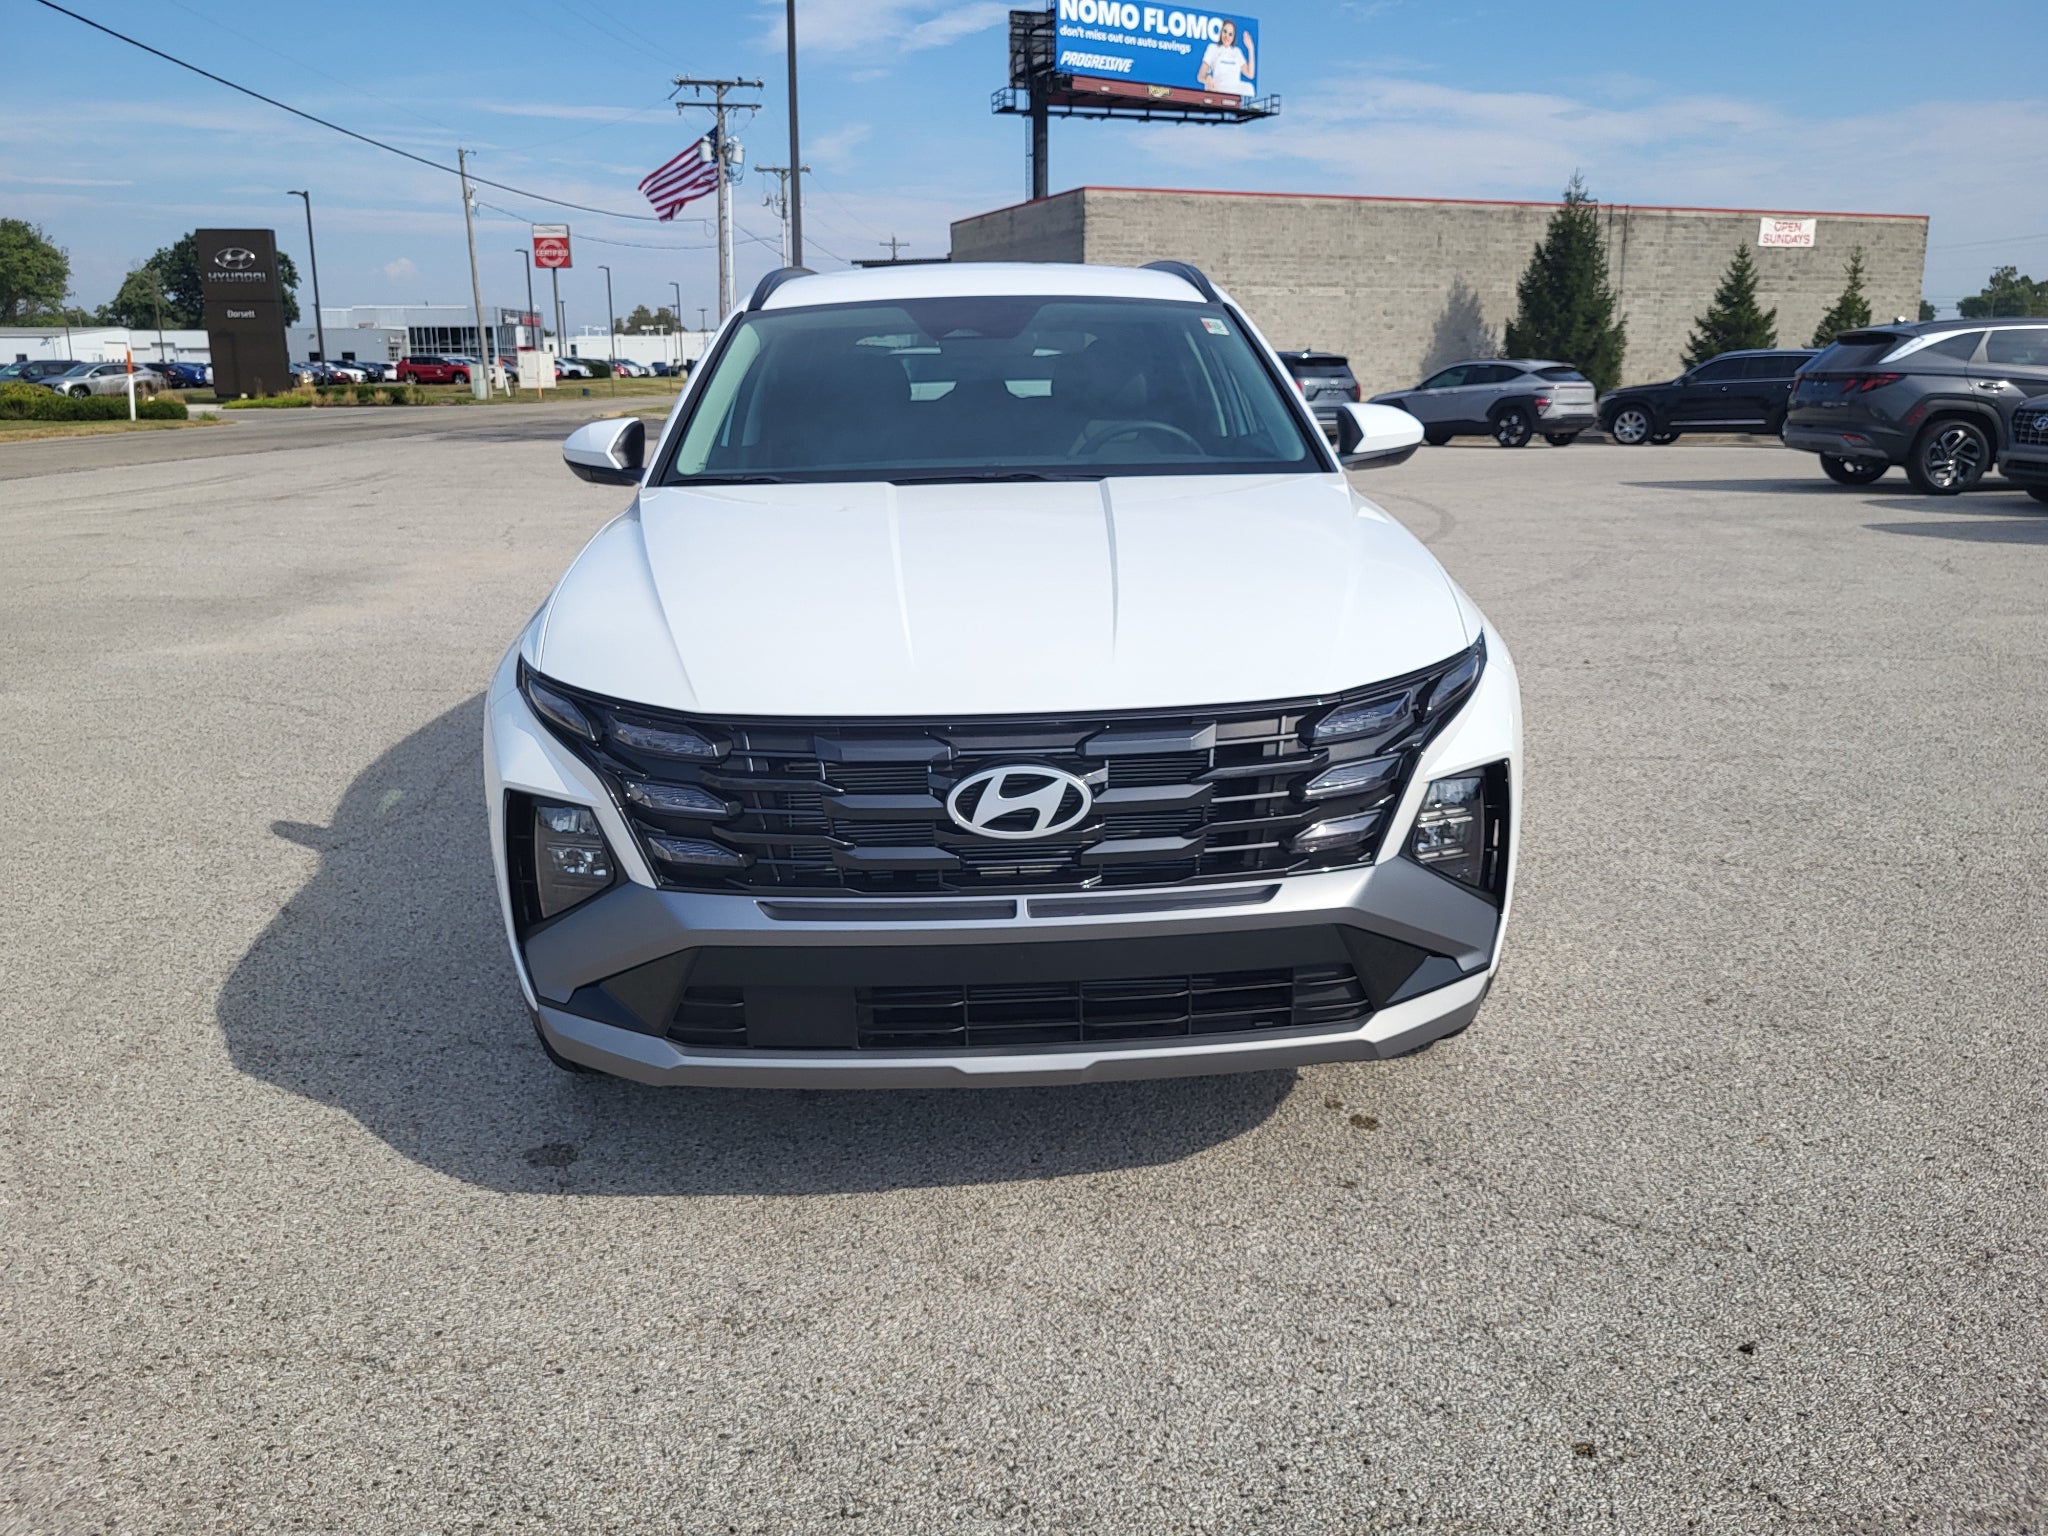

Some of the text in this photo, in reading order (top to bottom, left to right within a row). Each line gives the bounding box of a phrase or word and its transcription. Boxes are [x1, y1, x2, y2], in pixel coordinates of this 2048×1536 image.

[1060, 0, 1224, 43] NOMO FLOMO
[1060, 25, 1192, 55] don't miss out on auto savings
[1060, 50, 1134, 73] PROGRESSIVE
[1774, 221, 1802, 232] OPEN
[1763, 233, 1811, 244] SUNDAYS
[207, 271, 267, 283] HYUNDAI
[227, 309, 256, 318] Dorsett
